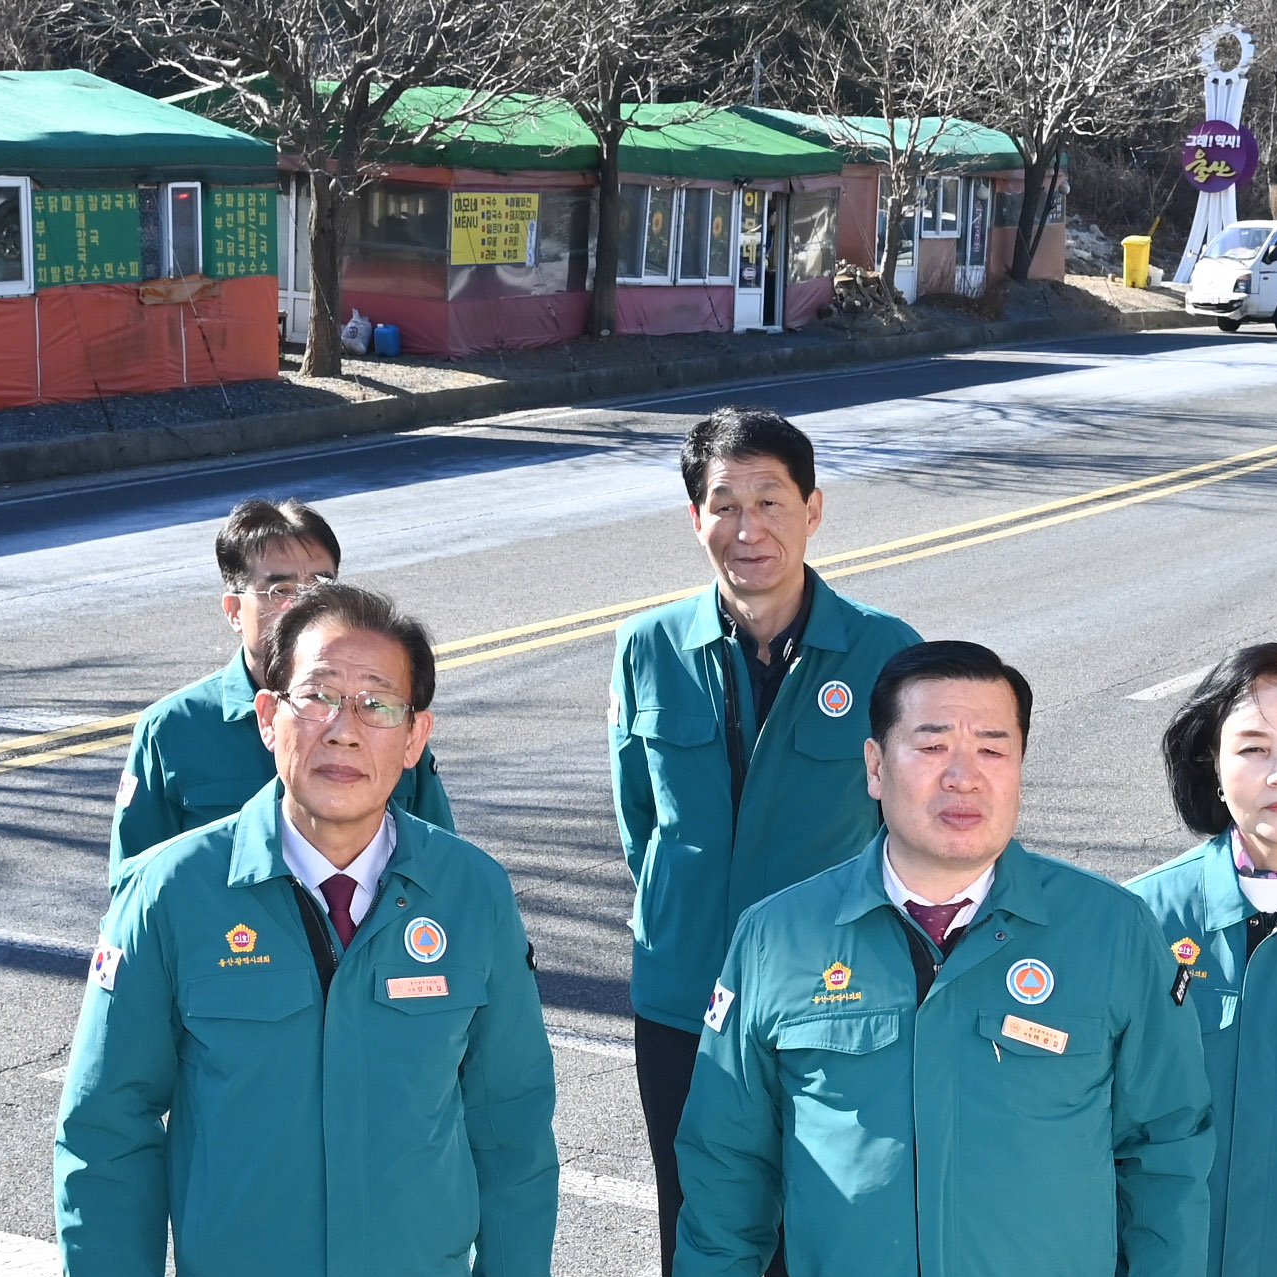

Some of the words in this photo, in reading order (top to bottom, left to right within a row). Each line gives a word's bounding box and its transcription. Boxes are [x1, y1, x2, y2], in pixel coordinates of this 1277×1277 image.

[1185, 134, 1213, 148] 그래!
[1214, 134, 1241, 149] 역시!
[1185, 148, 1237, 184] 울산
[454, 215, 478, 229] MENU
[217, 954, 272, 968] 울산광역시의회
[811, 991, 863, 1005] 울산광역시의회
